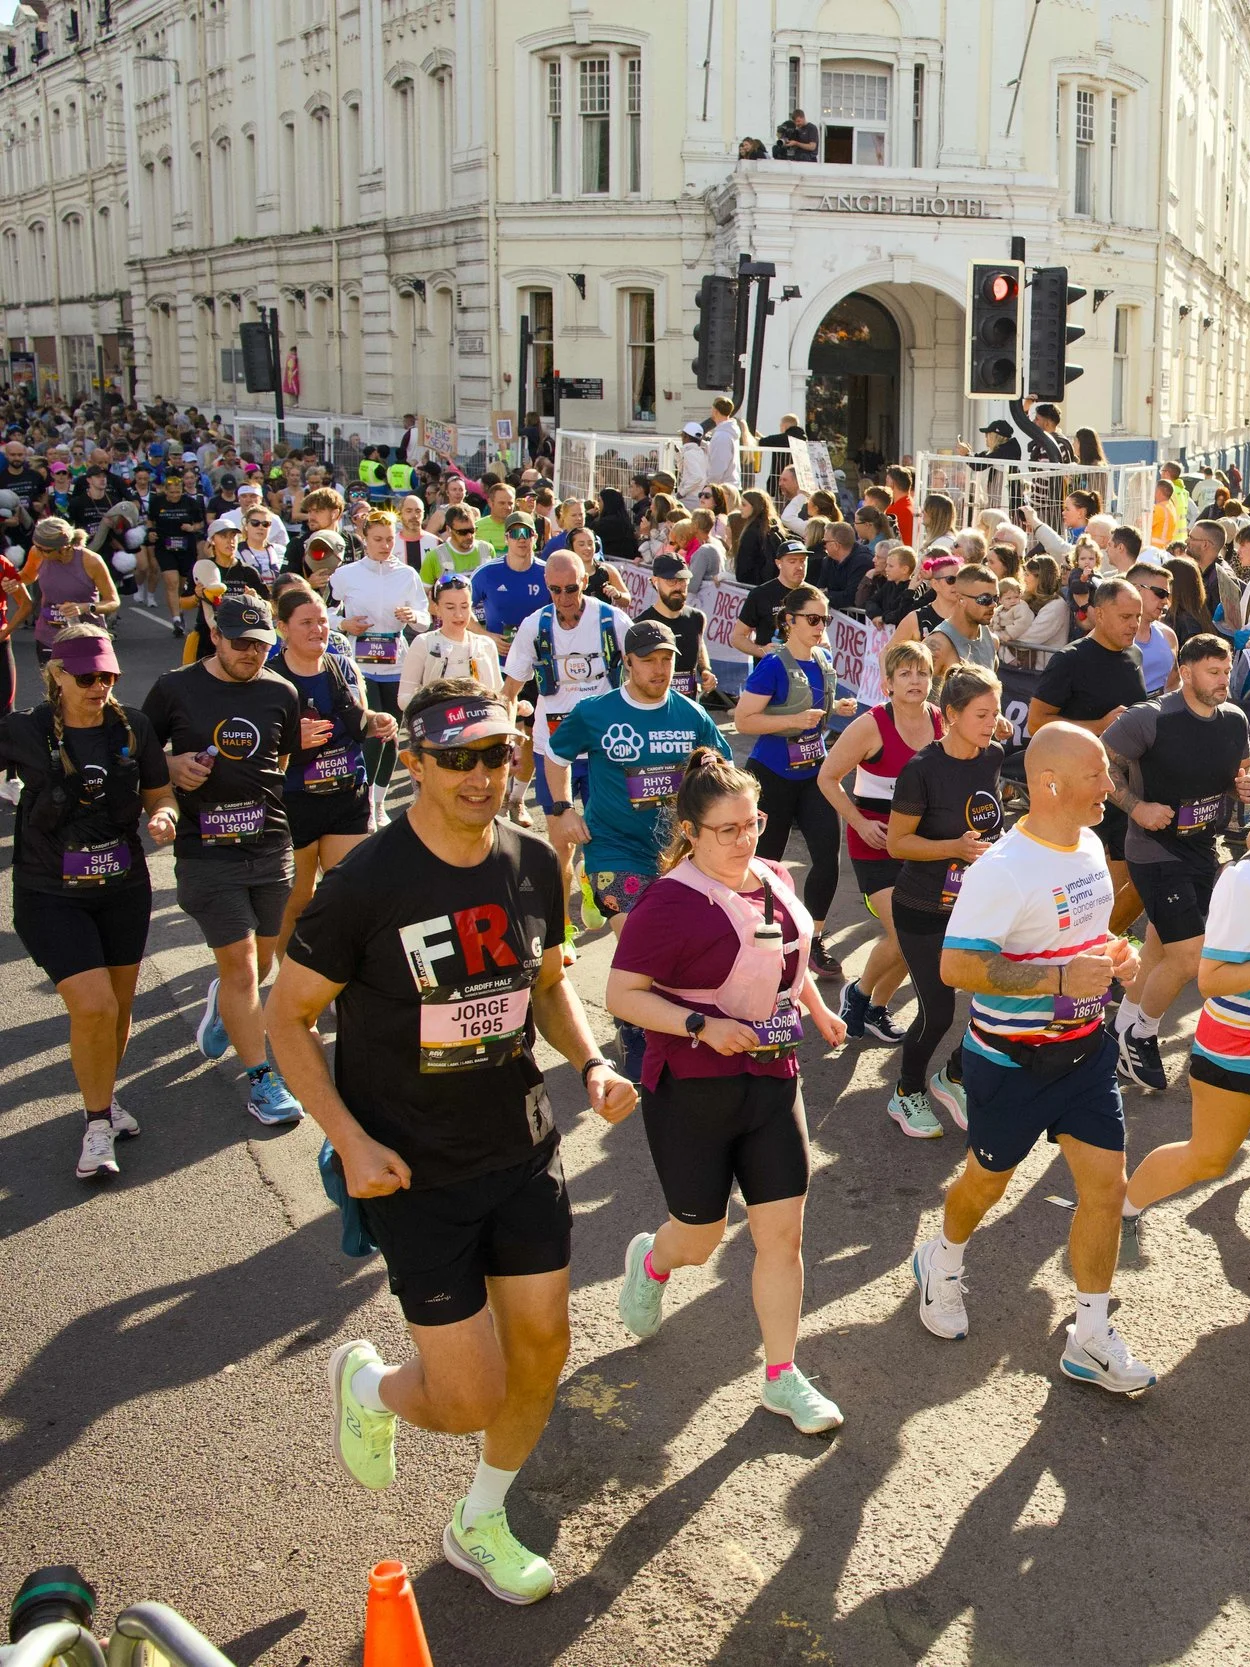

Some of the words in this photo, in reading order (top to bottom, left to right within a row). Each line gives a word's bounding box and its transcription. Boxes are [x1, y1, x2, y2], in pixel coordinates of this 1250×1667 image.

[818, 193, 900, 213] ANGEL
[910, 196, 990, 217] HOTEL
[528, 583, 540, 596] 19
[836, 621, 867, 656] BRE
[368, 649, 385, 657] 4249
[670, 677, 690, 686] ENRY
[448, 707, 466, 723] full
[222, 731, 253, 740] SUPER
[649, 730, 696, 741] RESCUE
[222, 739, 253, 747] HALFS
[649, 741, 694, 754] HOTEL
[613, 744, 631, 758] CDH
[315, 757, 348, 770] MEGAN
[319, 766, 348, 779] 16470
[643, 775, 672, 787] RHYS
[642, 785, 674, 797] 23424
[971, 802, 995, 816] SUPER
[1193, 802, 1220, 816] SIMON
[204, 808, 264, 825] JONATHAN
[972, 811, 997, 823] HALFS
[220, 821, 255, 834] 13690
[90, 853, 114, 865] SUE
[84, 862, 120, 875] 19678
[1065, 873, 1095, 894] ymchwil
[1070, 889, 1093, 904] cymru
[1072, 899, 1095, 916] cancer
[1073, 912, 1093, 927] wales
[399, 903, 519, 994] FR
[464, 981, 493, 994] CARDIFF
[494, 978, 513, 987] HALF
[451, 998, 509, 1022] JORGE
[1073, 1002, 1101, 1019] 18670
[460, 1017, 503, 1038] 1695
[768, 1028, 792, 1044] 9506
